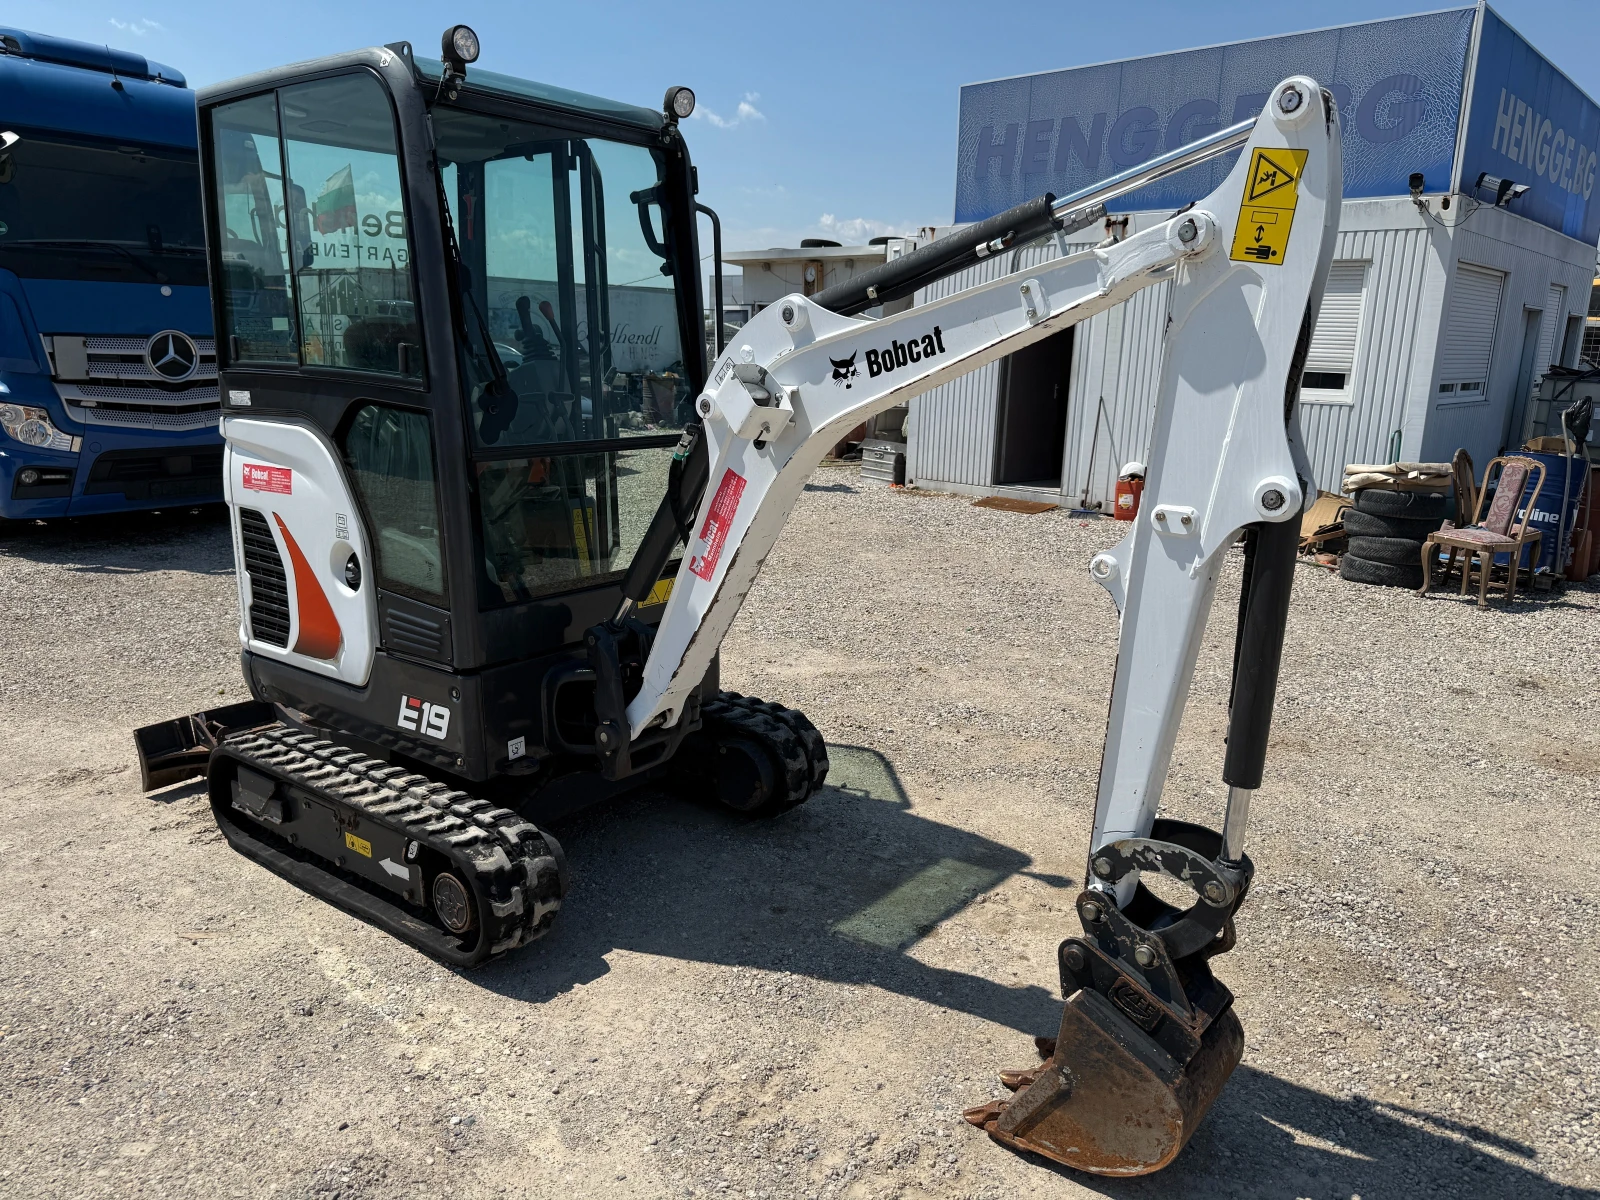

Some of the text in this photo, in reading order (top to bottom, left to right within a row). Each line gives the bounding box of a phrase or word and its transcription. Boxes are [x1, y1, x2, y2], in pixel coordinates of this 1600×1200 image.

[1492, 87, 1597, 201] HENGGE.BG
[865, 325, 946, 378] Bobcat
[251, 468, 269, 481] Bobcat
[397, 694, 451, 740] E19
